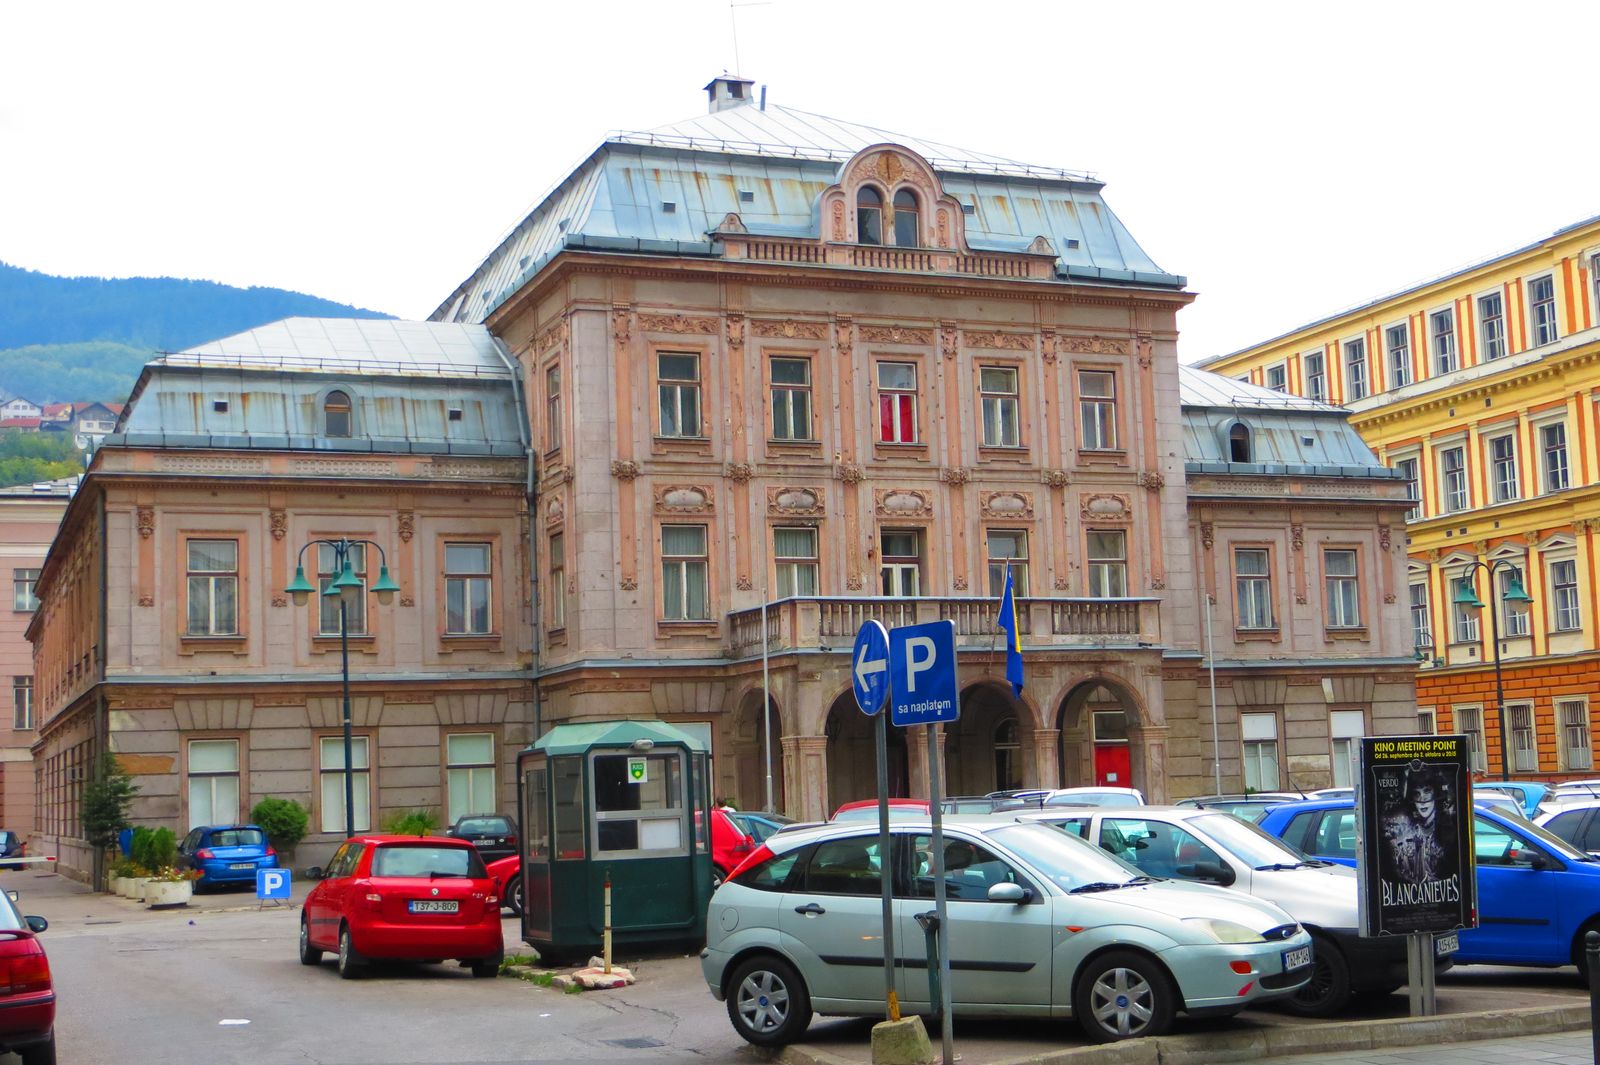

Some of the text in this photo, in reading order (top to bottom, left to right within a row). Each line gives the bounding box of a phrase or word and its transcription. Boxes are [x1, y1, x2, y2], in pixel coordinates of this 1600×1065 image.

[905, 636, 937, 693] P
[898, 700, 951, 715] sa naplatom
[1374, 740, 1457, 752] KINO MEETING POINT
[264, 873, 283, 895] P
[414, 902, 457, 911] T37-J-809
